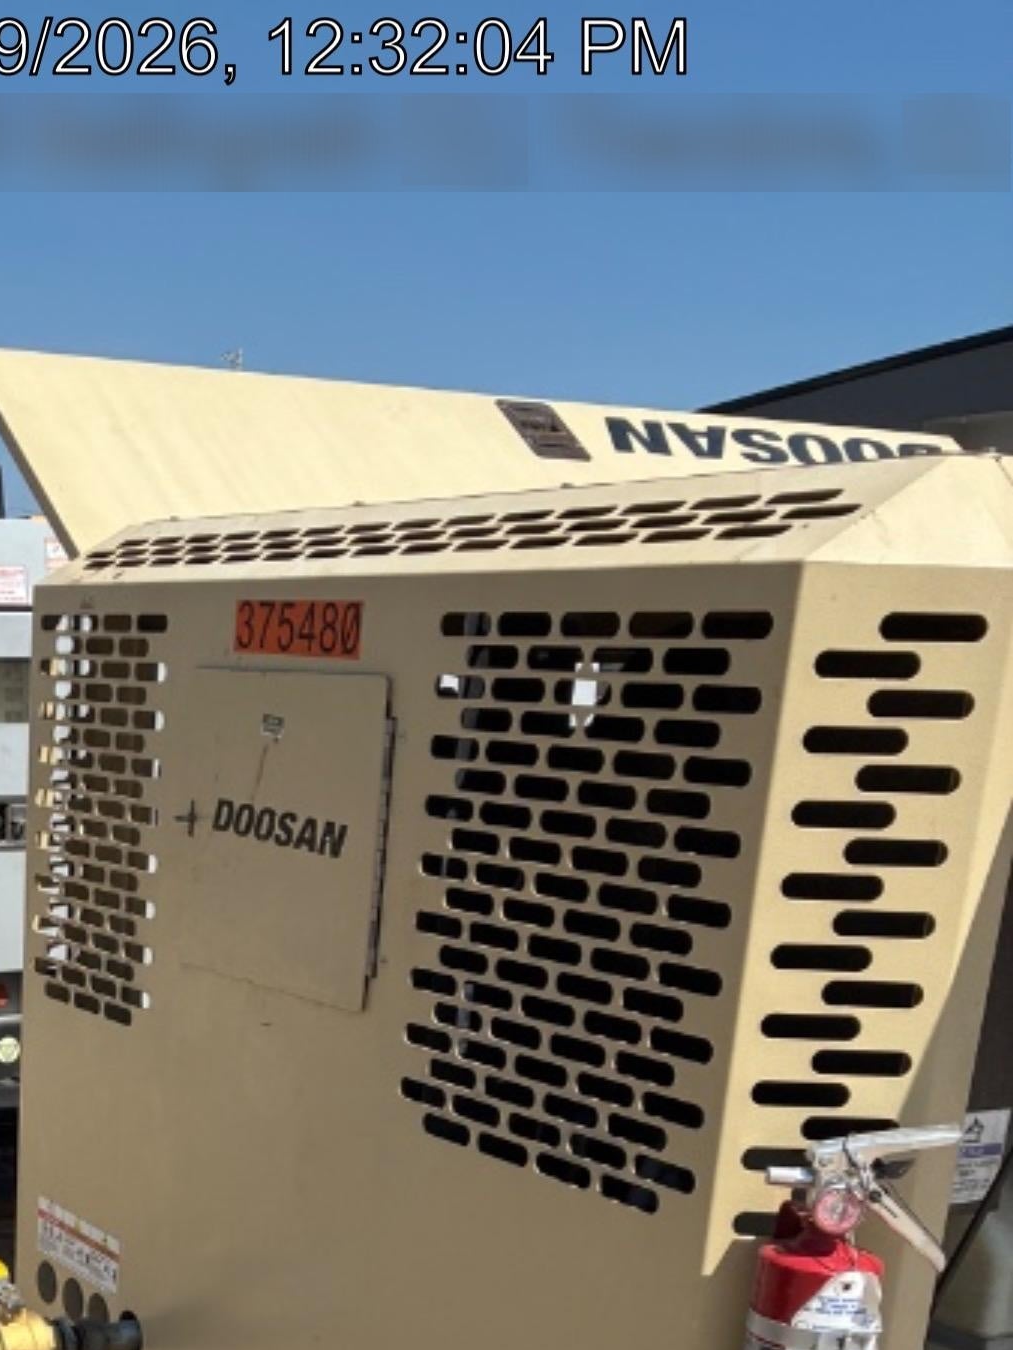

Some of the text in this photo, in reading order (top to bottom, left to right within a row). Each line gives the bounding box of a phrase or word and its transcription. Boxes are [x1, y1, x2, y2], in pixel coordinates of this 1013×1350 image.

[604, 416, 943, 465] OOSAN
[238, 600, 360, 655] 375480
[212, 798, 348, 858] DOOSAN
